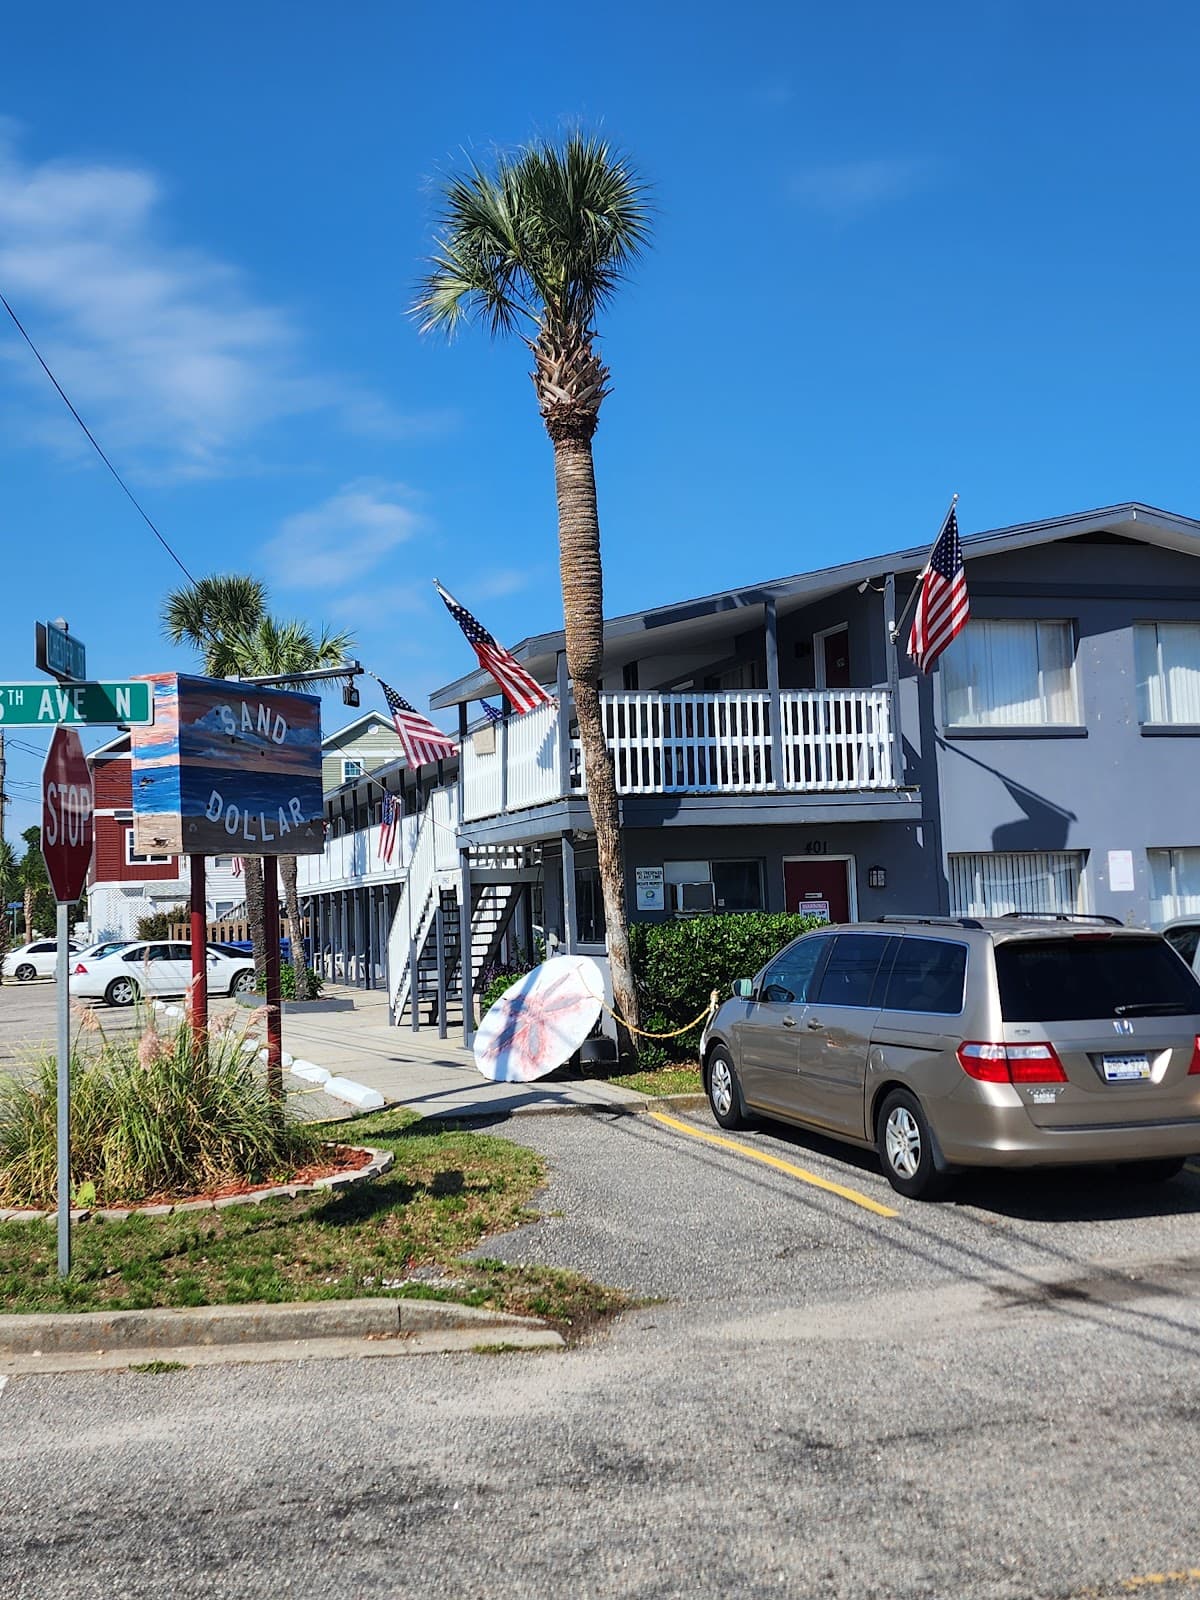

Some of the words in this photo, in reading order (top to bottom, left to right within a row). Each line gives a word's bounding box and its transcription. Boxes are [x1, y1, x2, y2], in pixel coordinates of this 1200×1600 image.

[38, 688, 87, 720] AVE
[115, 687, 131, 719] N
[220, 701, 287, 745] SAND
[46, 781, 91, 847] STOP
[205, 790, 306, 842] DOLLAR
[805, 840, 827, 853] 401
